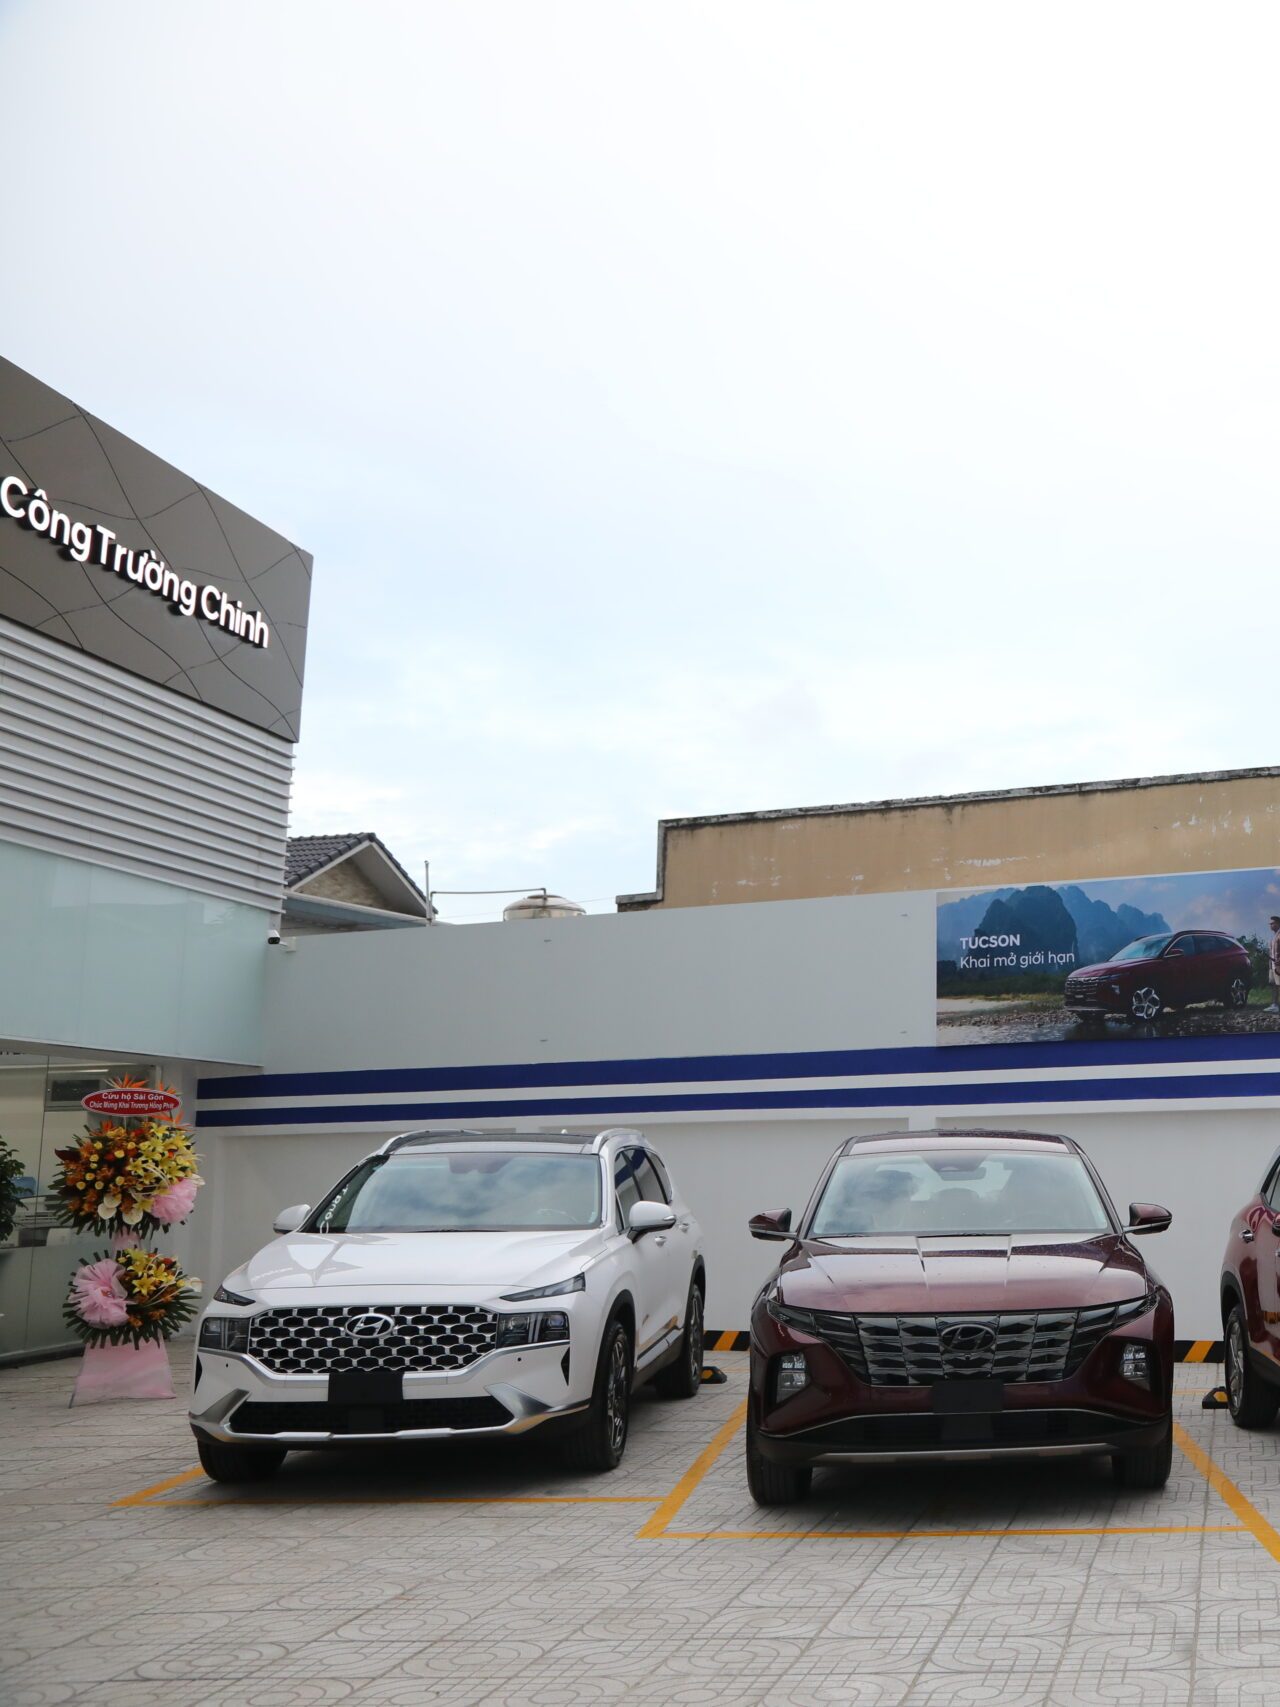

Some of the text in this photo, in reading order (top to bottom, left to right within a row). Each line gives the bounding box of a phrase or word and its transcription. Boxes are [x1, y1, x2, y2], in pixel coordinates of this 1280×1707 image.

[0, 475, 269, 648] Công Trường Chinh
[960, 934, 1021, 949] TUCSON
[960, 950, 1075, 969] Khai mở giới hạn
